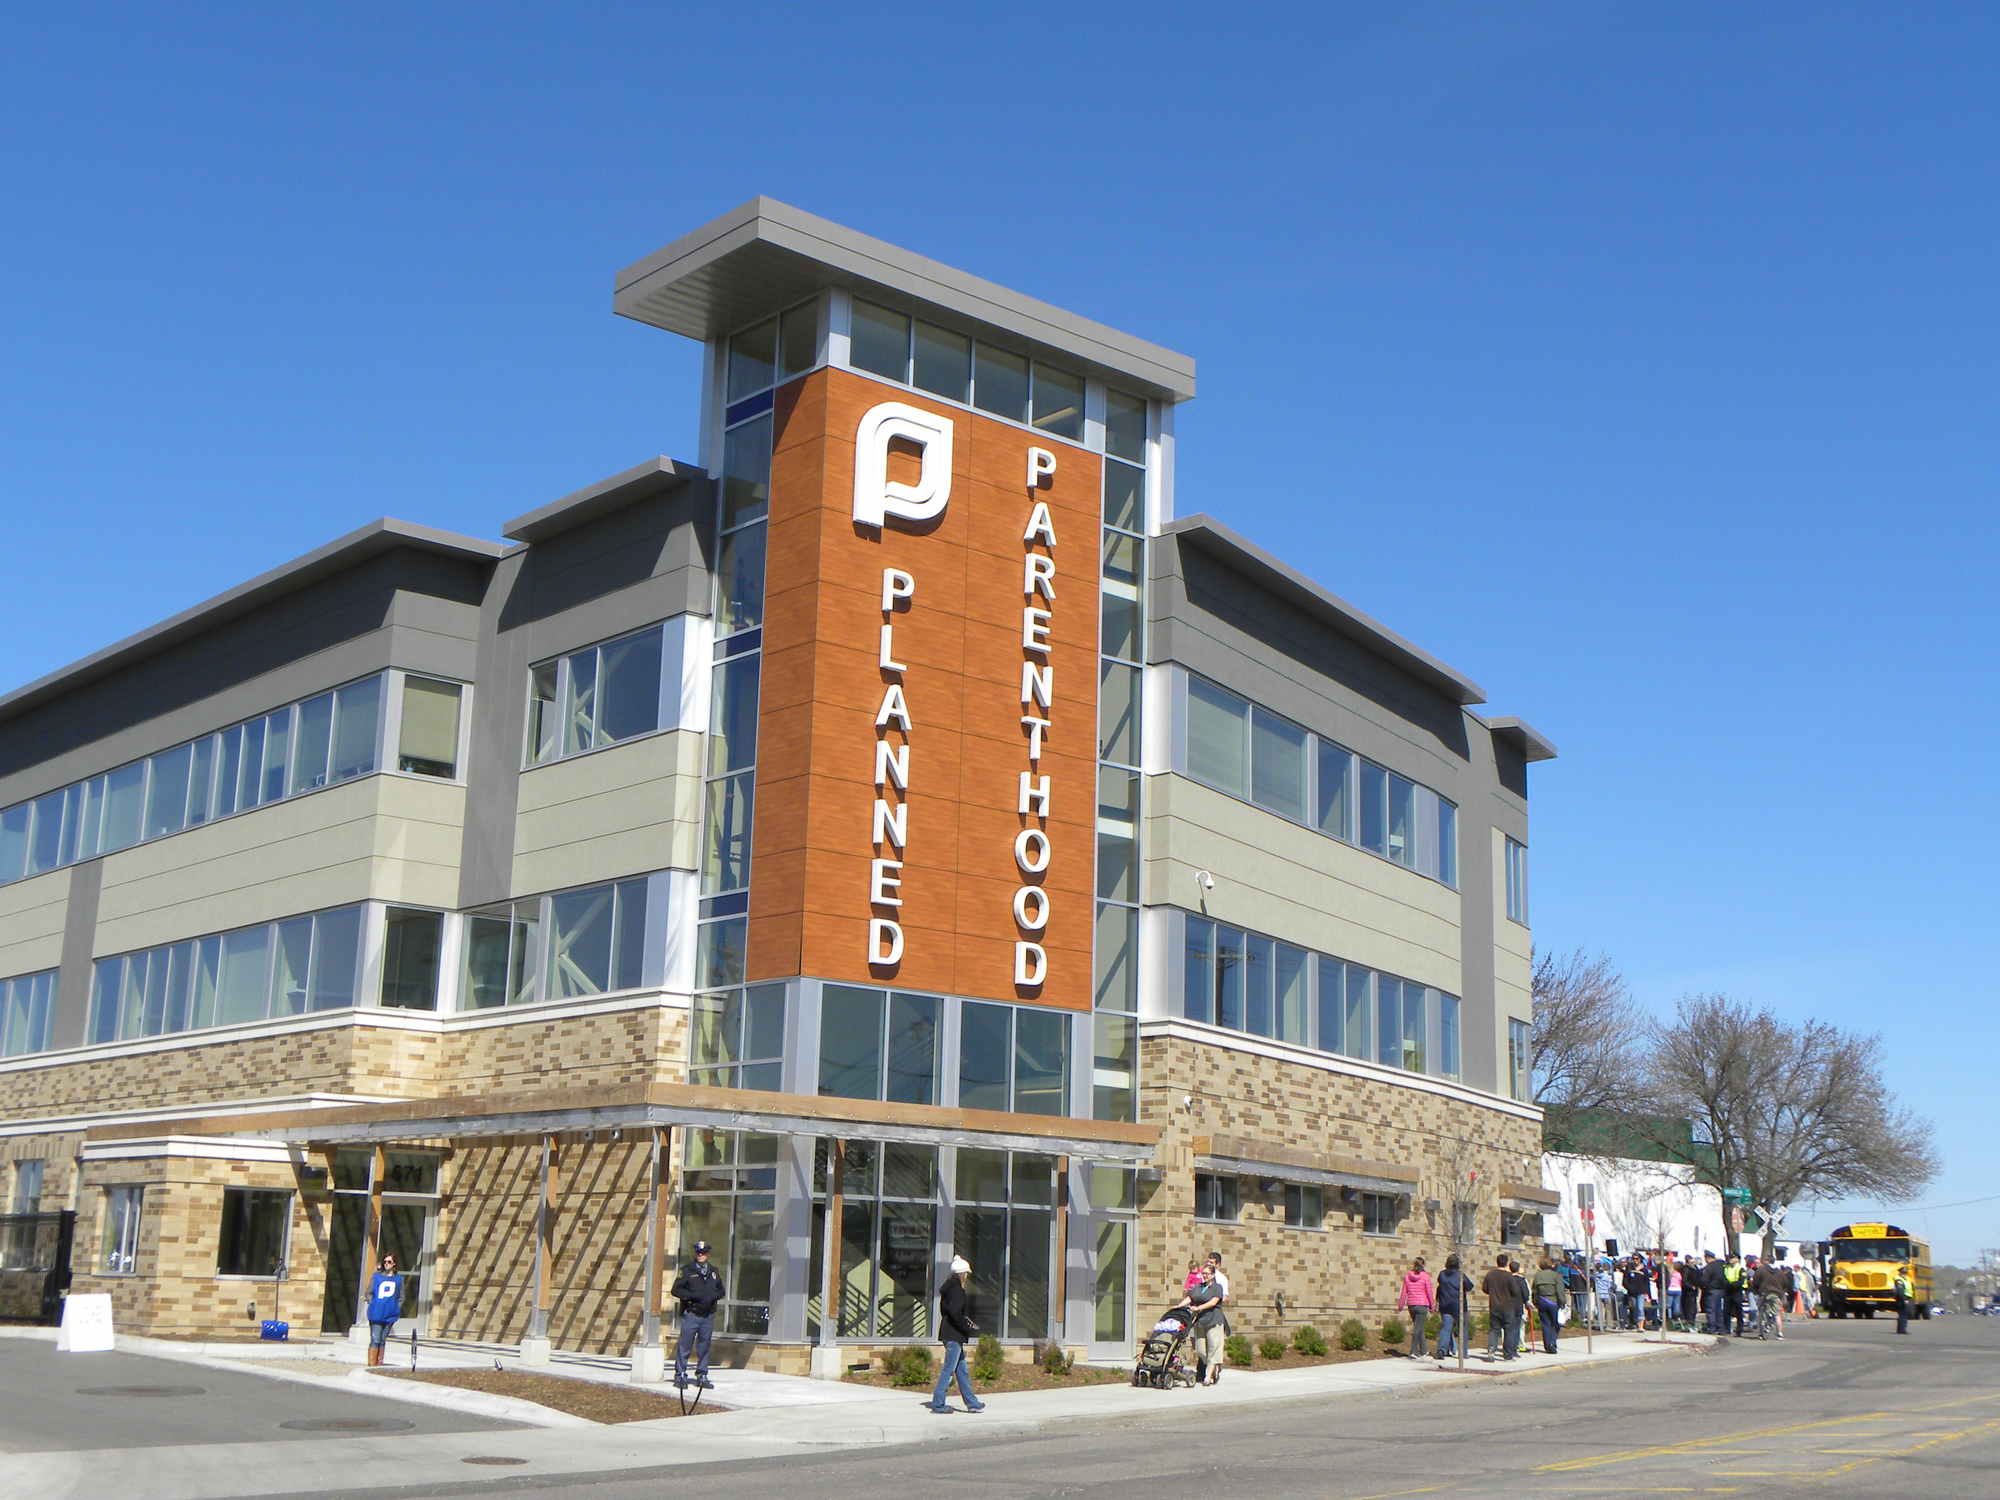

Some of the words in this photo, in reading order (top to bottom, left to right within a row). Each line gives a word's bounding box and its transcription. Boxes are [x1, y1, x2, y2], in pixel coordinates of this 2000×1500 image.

[868, 568, 915, 965] PLANNED
[1014, 446, 1057, 986] PARENTHOOD
[392, 1165, 422, 1182] 671
